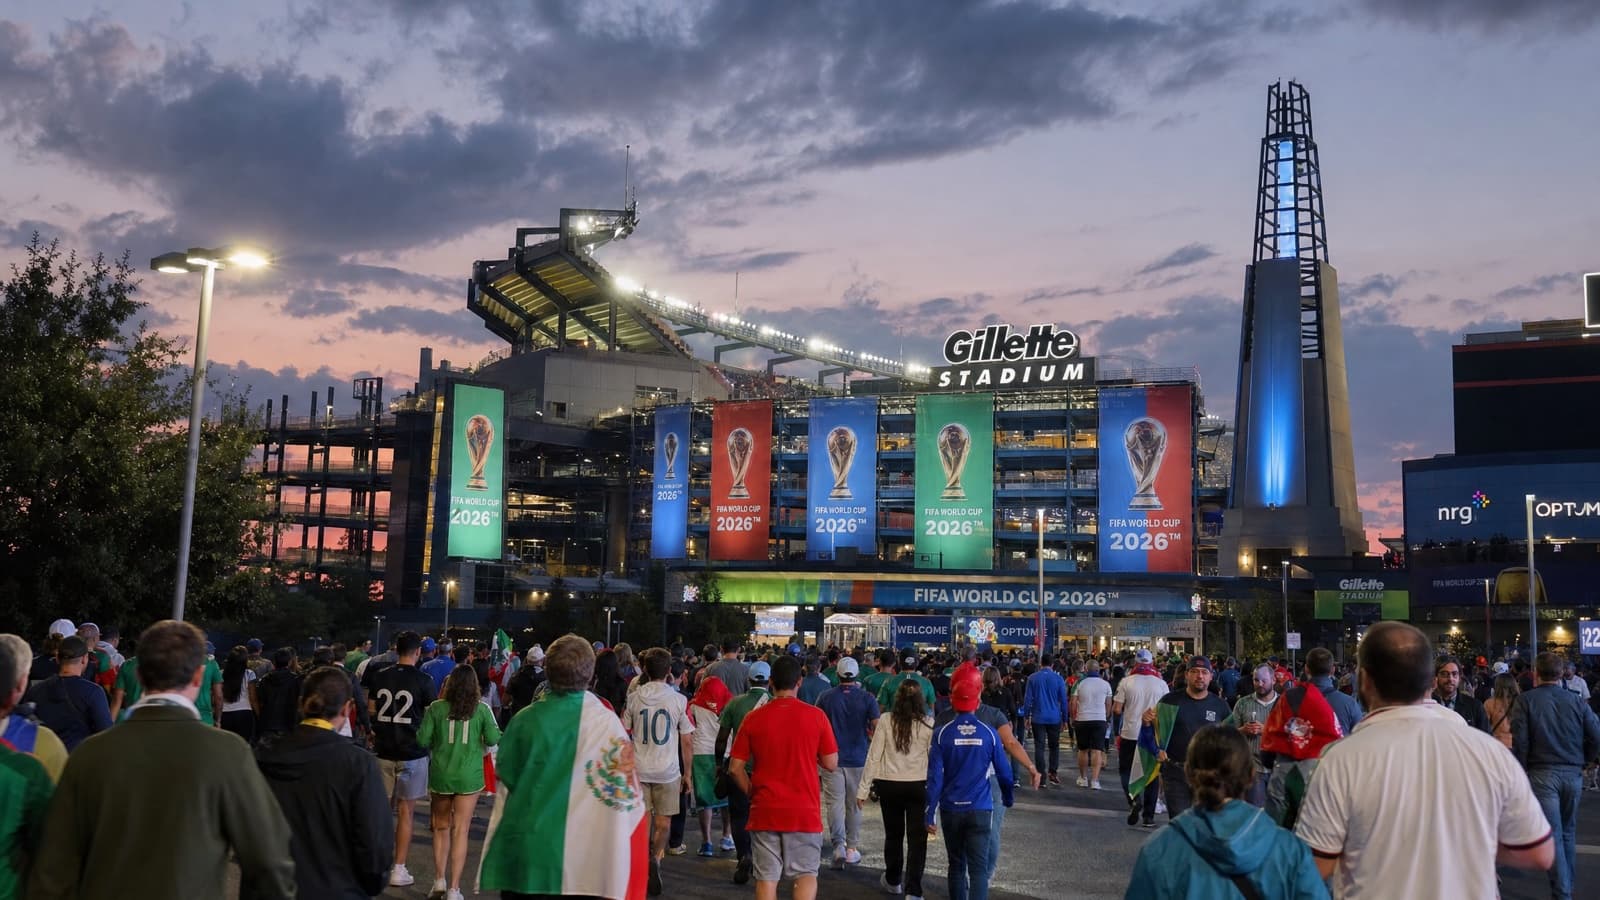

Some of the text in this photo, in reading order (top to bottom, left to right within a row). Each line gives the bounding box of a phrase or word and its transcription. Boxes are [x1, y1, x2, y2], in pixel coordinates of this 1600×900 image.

[943, 323, 1078, 365] Gillette
[938, 363, 1084, 388] STADIUM
[487, 498, 500, 507] CUP
[749, 504, 761, 513] CUP
[829, 506, 852, 514] WORLD
[852, 506, 867, 514] CUP
[925, 508, 983, 516] FIFA WORLD CUP
[1438, 506, 1472, 525] nrg
[1109, 519, 1181, 528] FIFA WORLD CUP
[1339, 578, 1385, 591] Gillette
[914, 588, 949, 603] FIFA
[952, 589, 1014, 604] WORLD
[1018, 590, 1055, 605] CUP
[1339, 592, 1384, 600] STADIUM
[897, 625, 948, 635] WELCOME
[376, 688, 414, 725] 22
[639, 708, 671, 746] 10
